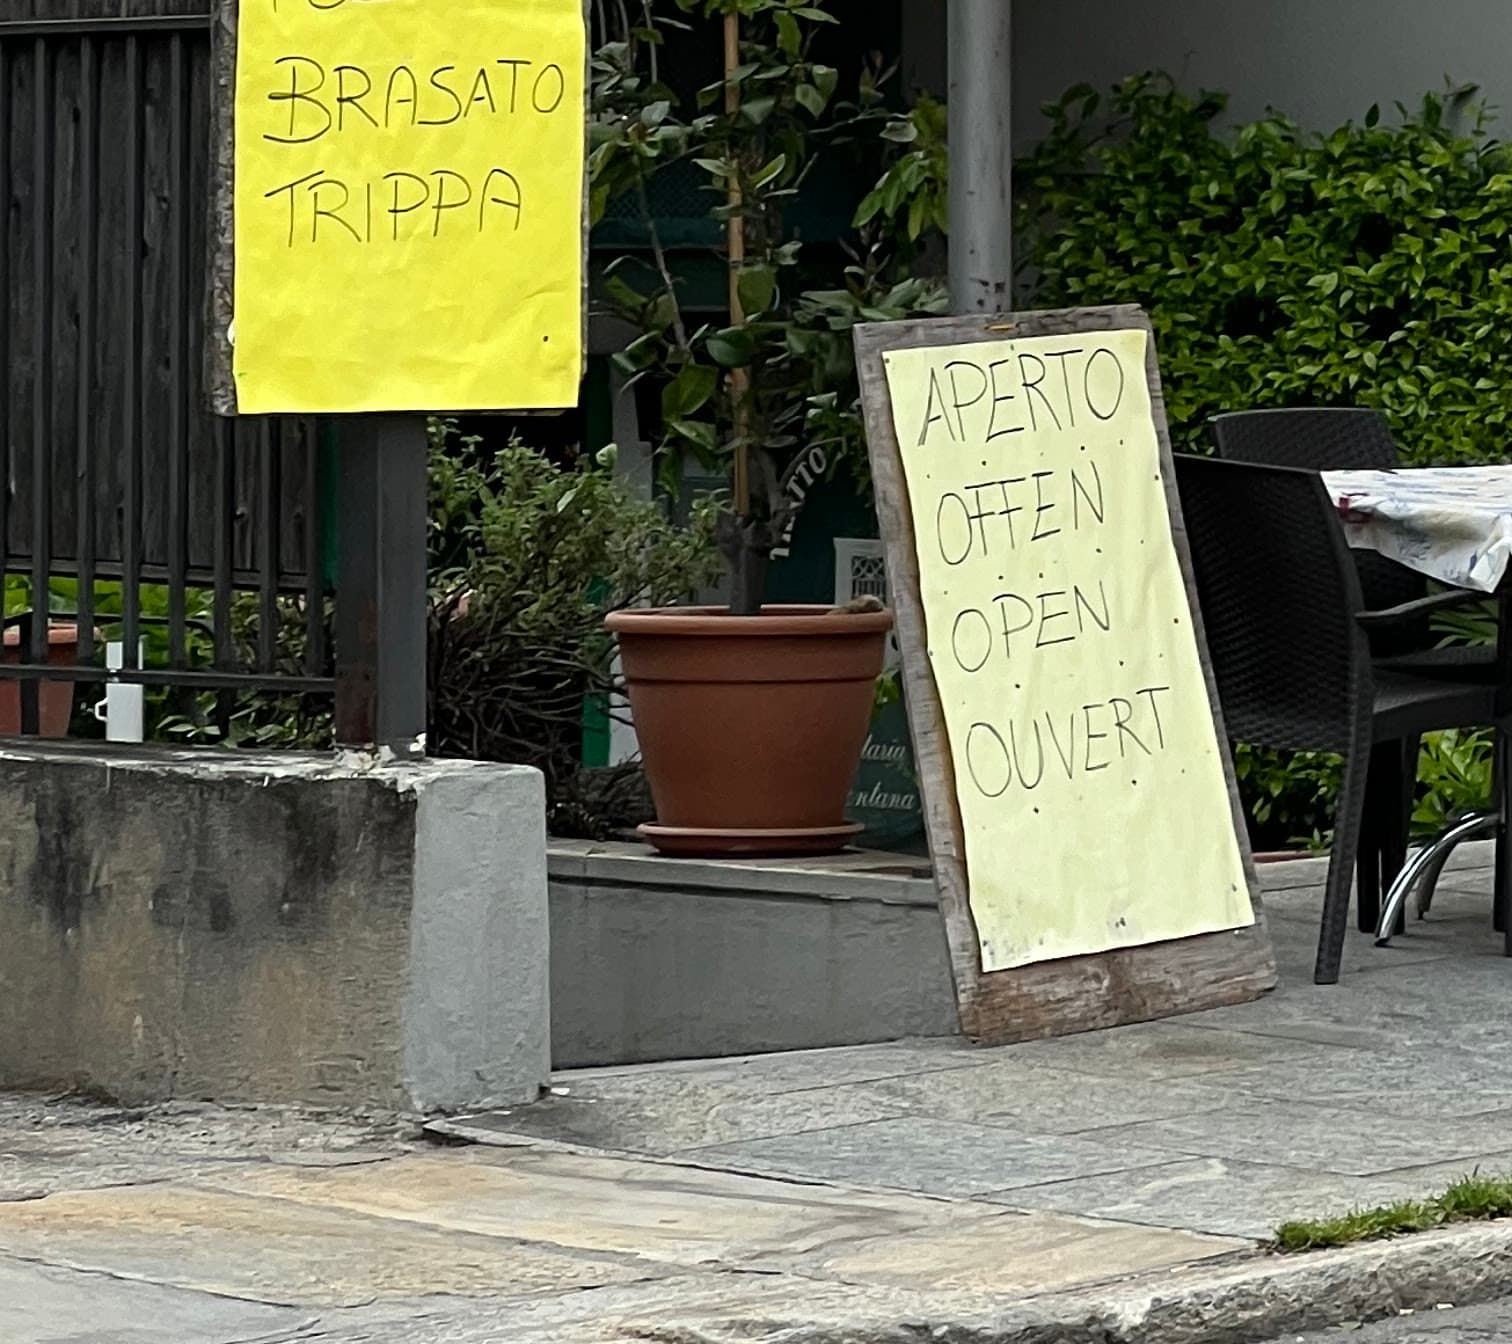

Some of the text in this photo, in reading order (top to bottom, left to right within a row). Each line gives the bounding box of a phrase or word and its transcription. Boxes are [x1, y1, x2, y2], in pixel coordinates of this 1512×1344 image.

[262, 56, 565, 144] BRASATO
[263, 168, 522, 249] TRIPPA
[917, 347, 1125, 447] APERTO
[936, 459, 1105, 566] OFFEN
[951, 579, 1111, 673] OPEN
[964, 686, 1170, 798] OUVERT
